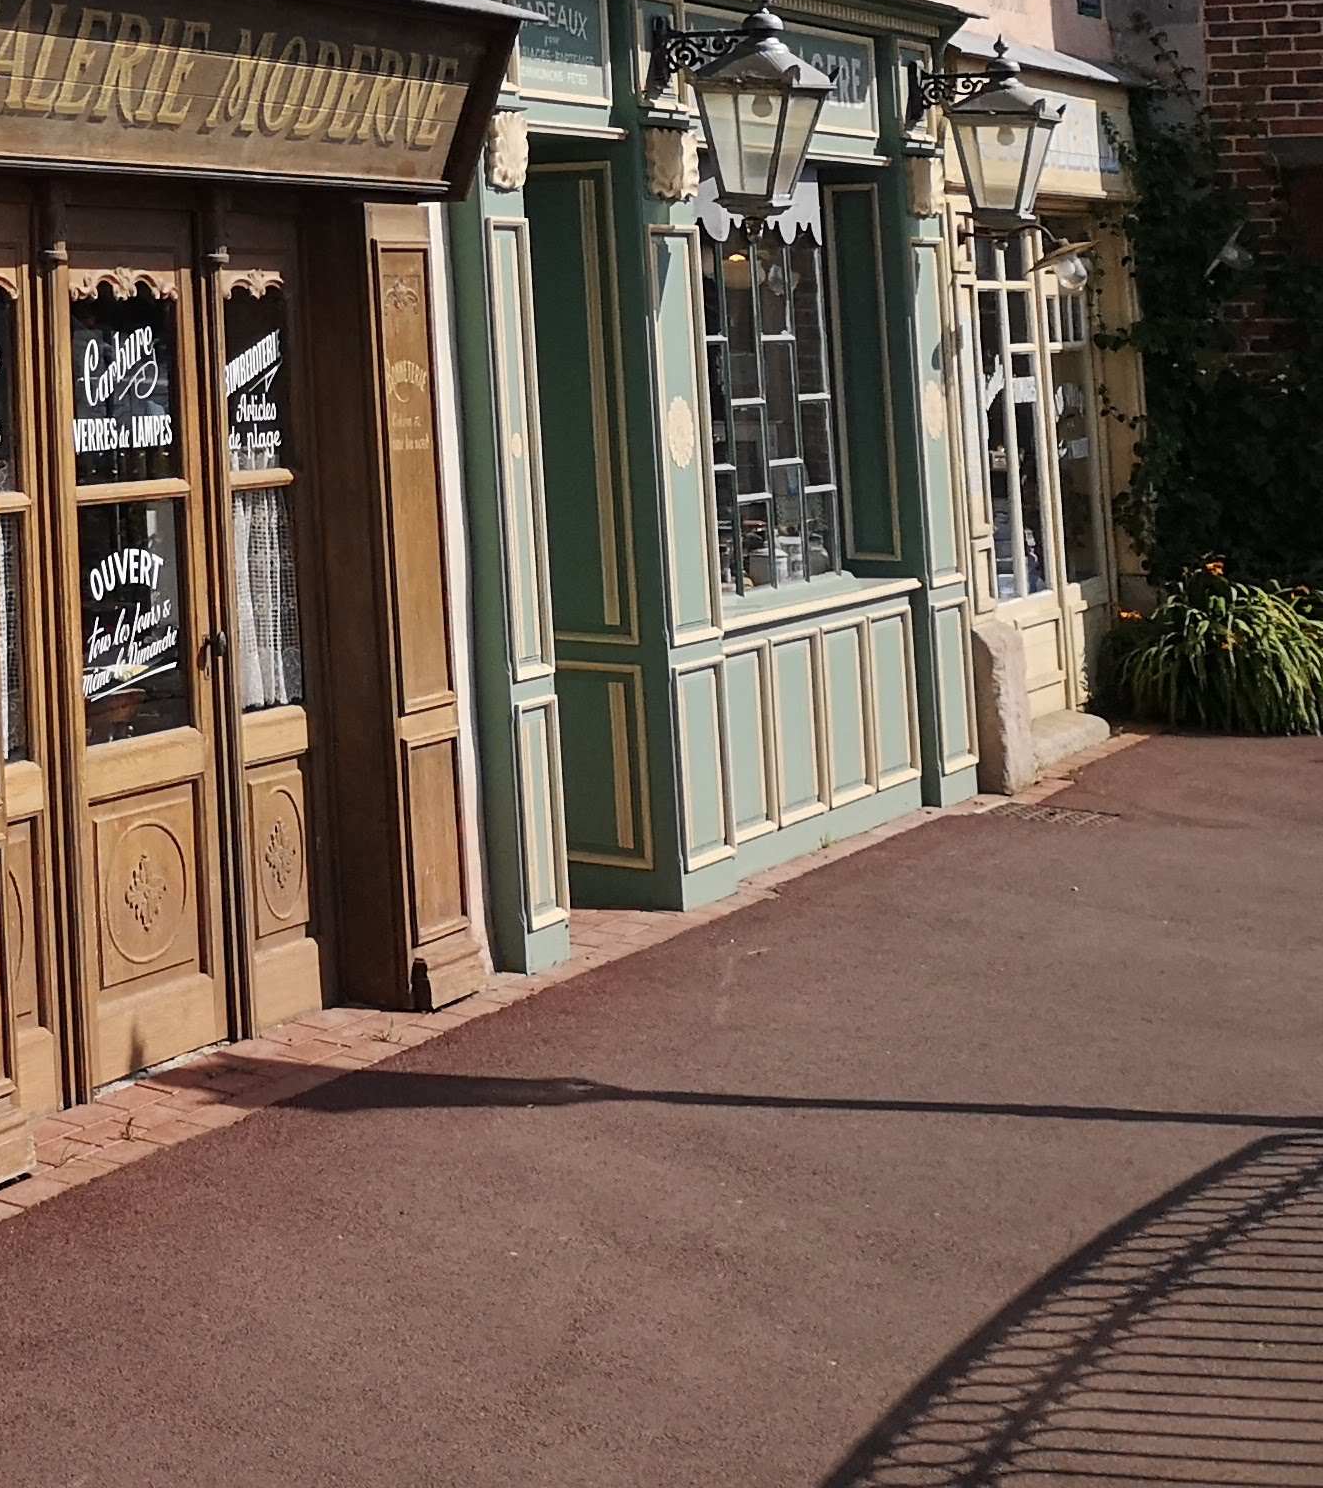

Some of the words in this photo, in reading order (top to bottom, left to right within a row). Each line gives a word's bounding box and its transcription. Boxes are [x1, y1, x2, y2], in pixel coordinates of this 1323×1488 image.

[205, 27, 459, 148] MODERNE
[83, 325, 158, 406] Carbure
[236, 394, 276, 423] Articles
[73, 417, 117, 452] VERRES
[119, 424, 130, 449] de
[132, 414, 172, 448] LAMPES
[229, 426, 241, 450] de
[247, 425, 282, 459] plage
[90, 548, 164, 601] OUVERT
